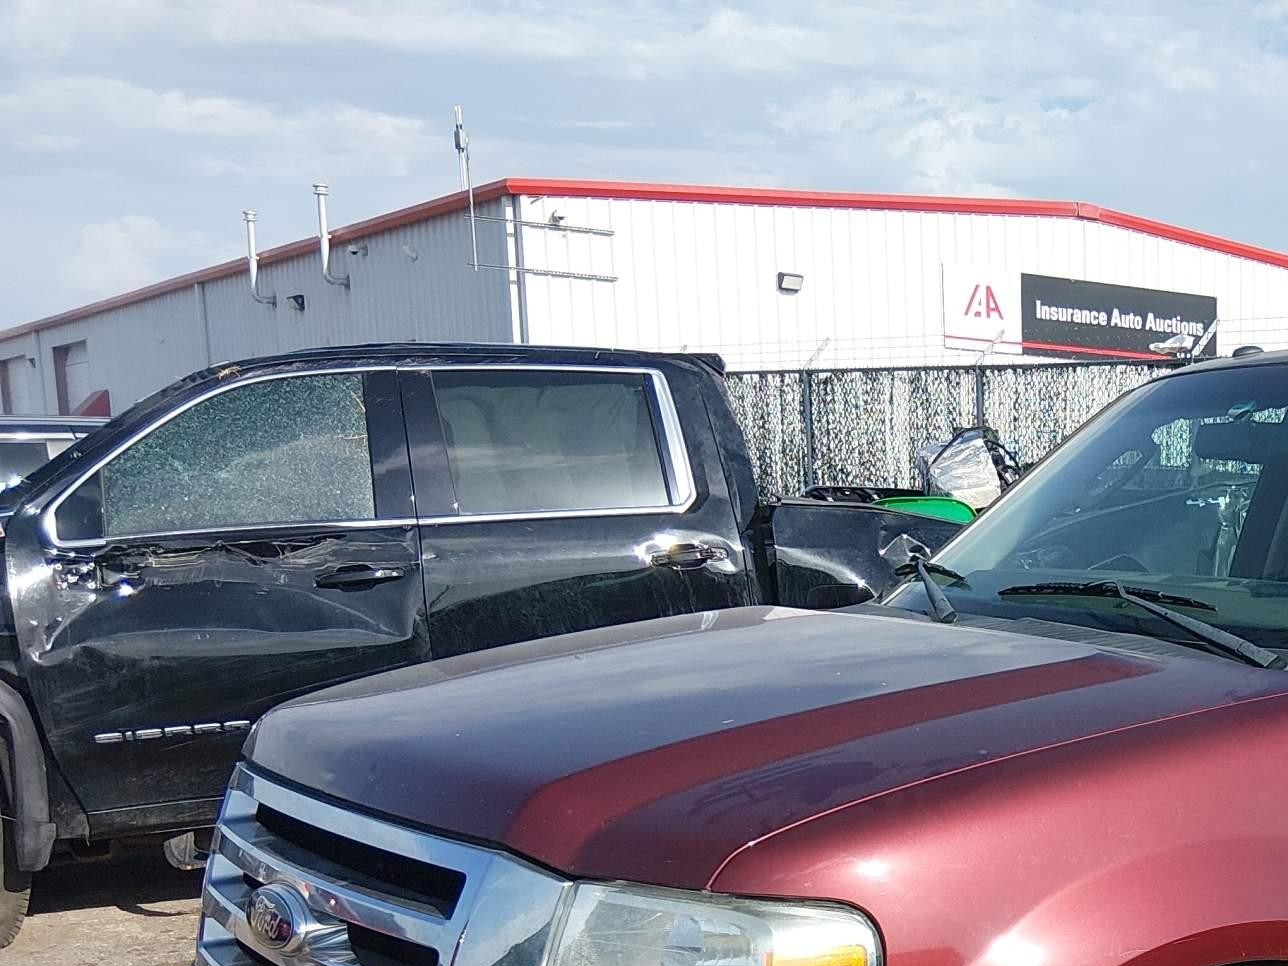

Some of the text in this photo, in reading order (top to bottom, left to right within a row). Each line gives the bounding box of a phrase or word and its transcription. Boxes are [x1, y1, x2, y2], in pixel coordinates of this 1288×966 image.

[1035, 299, 1205, 337] Insurance Auto Auctions
[94, 720, 250, 744] SIERRA
